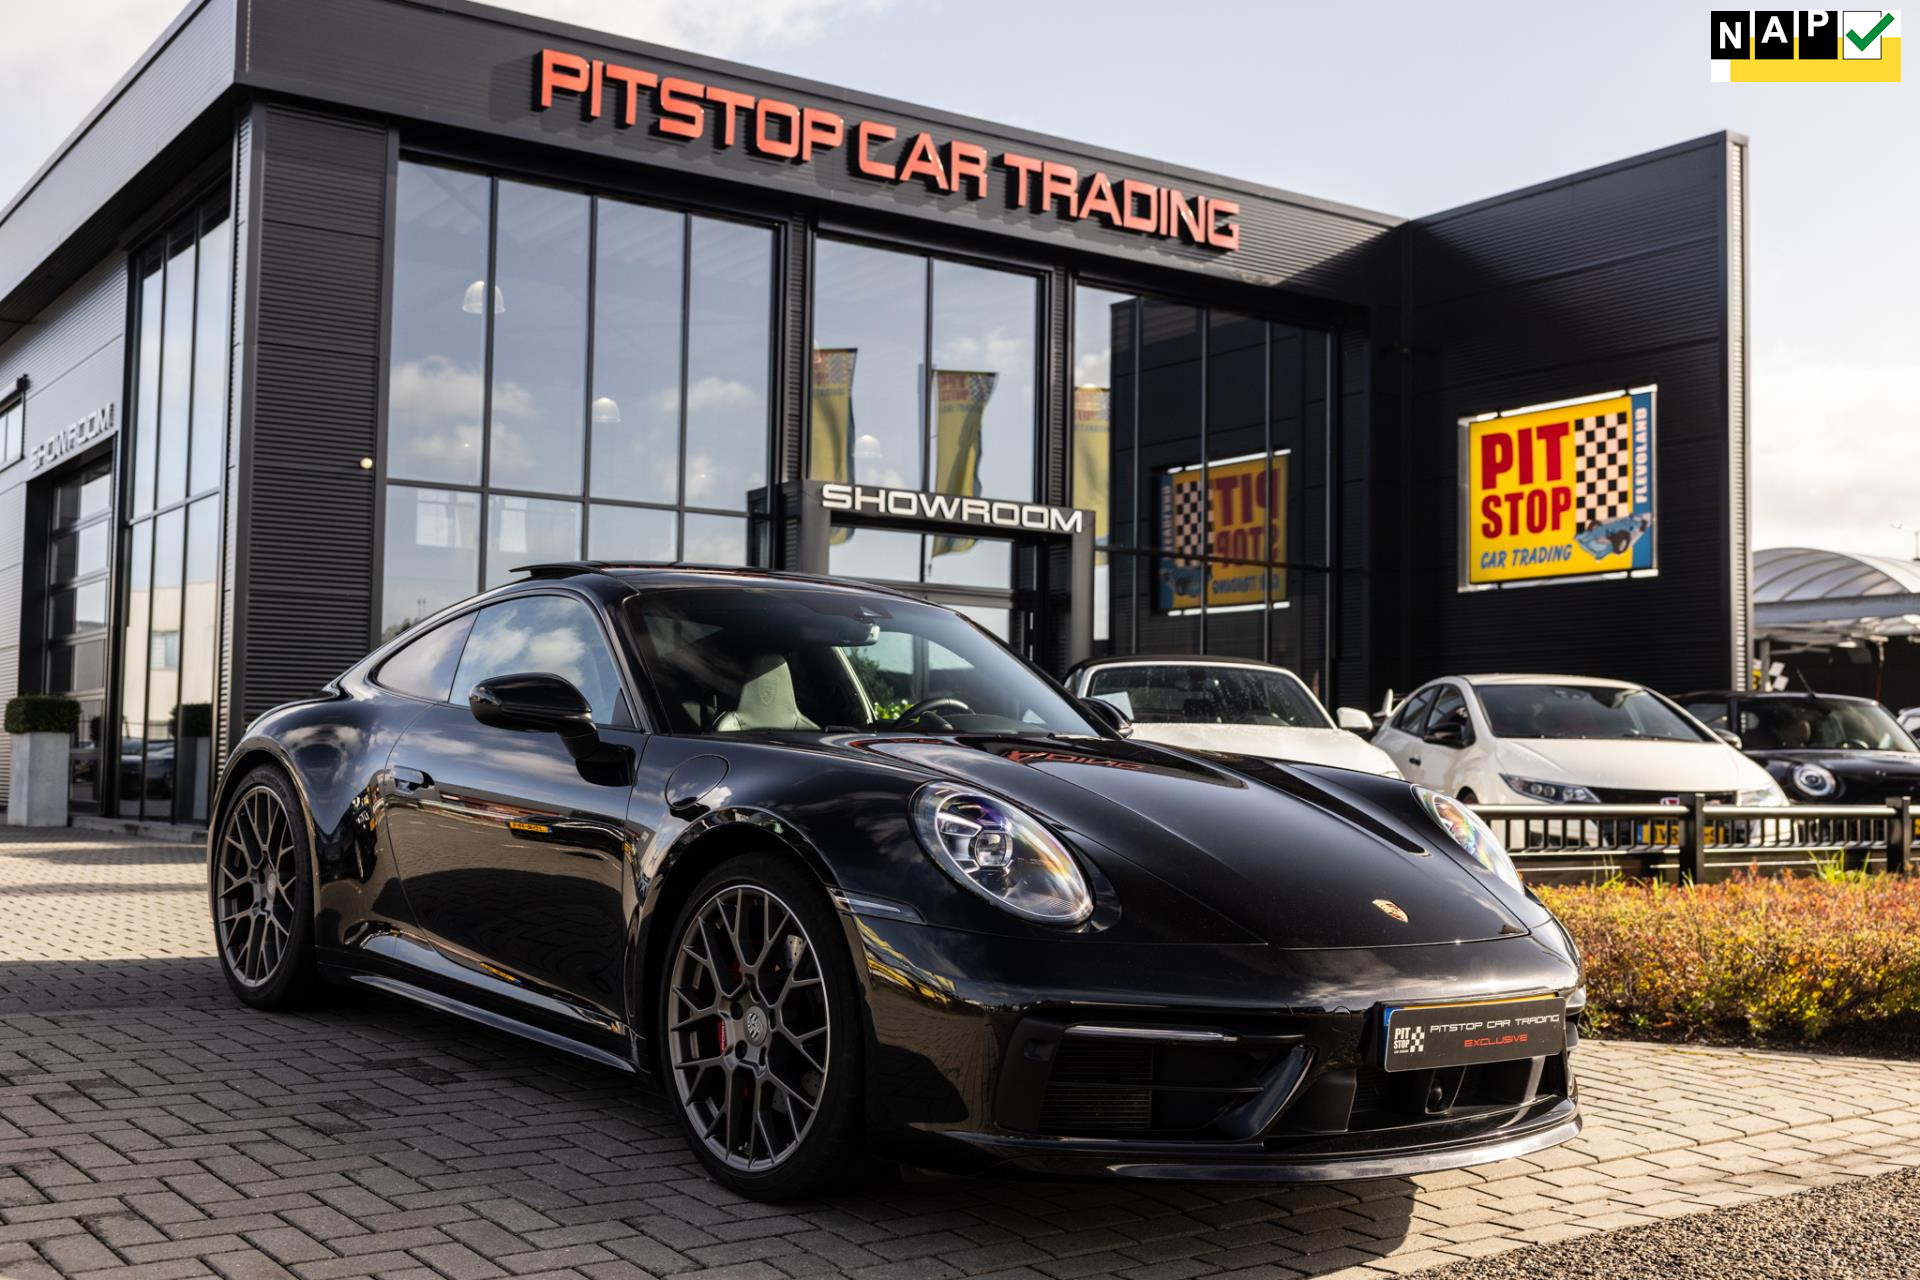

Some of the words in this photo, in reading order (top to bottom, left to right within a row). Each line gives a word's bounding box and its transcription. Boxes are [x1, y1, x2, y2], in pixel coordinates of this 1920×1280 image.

[541, 49, 844, 161] PITSTOP
[858, 121, 988, 198] CAR
[1004, 153, 1240, 251] TRADING
[29, 402, 115, 471] SHOWROOM
[1481, 421, 1570, 490] PIT
[1635, 407, 1648, 504] FLEVOLAND
[822, 483, 1083, 533] SHOWROOM
[1481, 486, 1571, 539] STOP
[1480, 550, 1507, 569] CAR
[1512, 543, 1573, 565] TRADING
[1393, 1039, 1410, 1050] STOP
[1394, 1027, 1411, 1040] PIT
[1429, 1021, 1483, 1033] PITSTOP
[1486, 1019, 1512, 1029] CAR
[1514, 1014, 1561, 1026] TRADING
[1463, 1034, 1529, 1048] EXCLUSIVE
